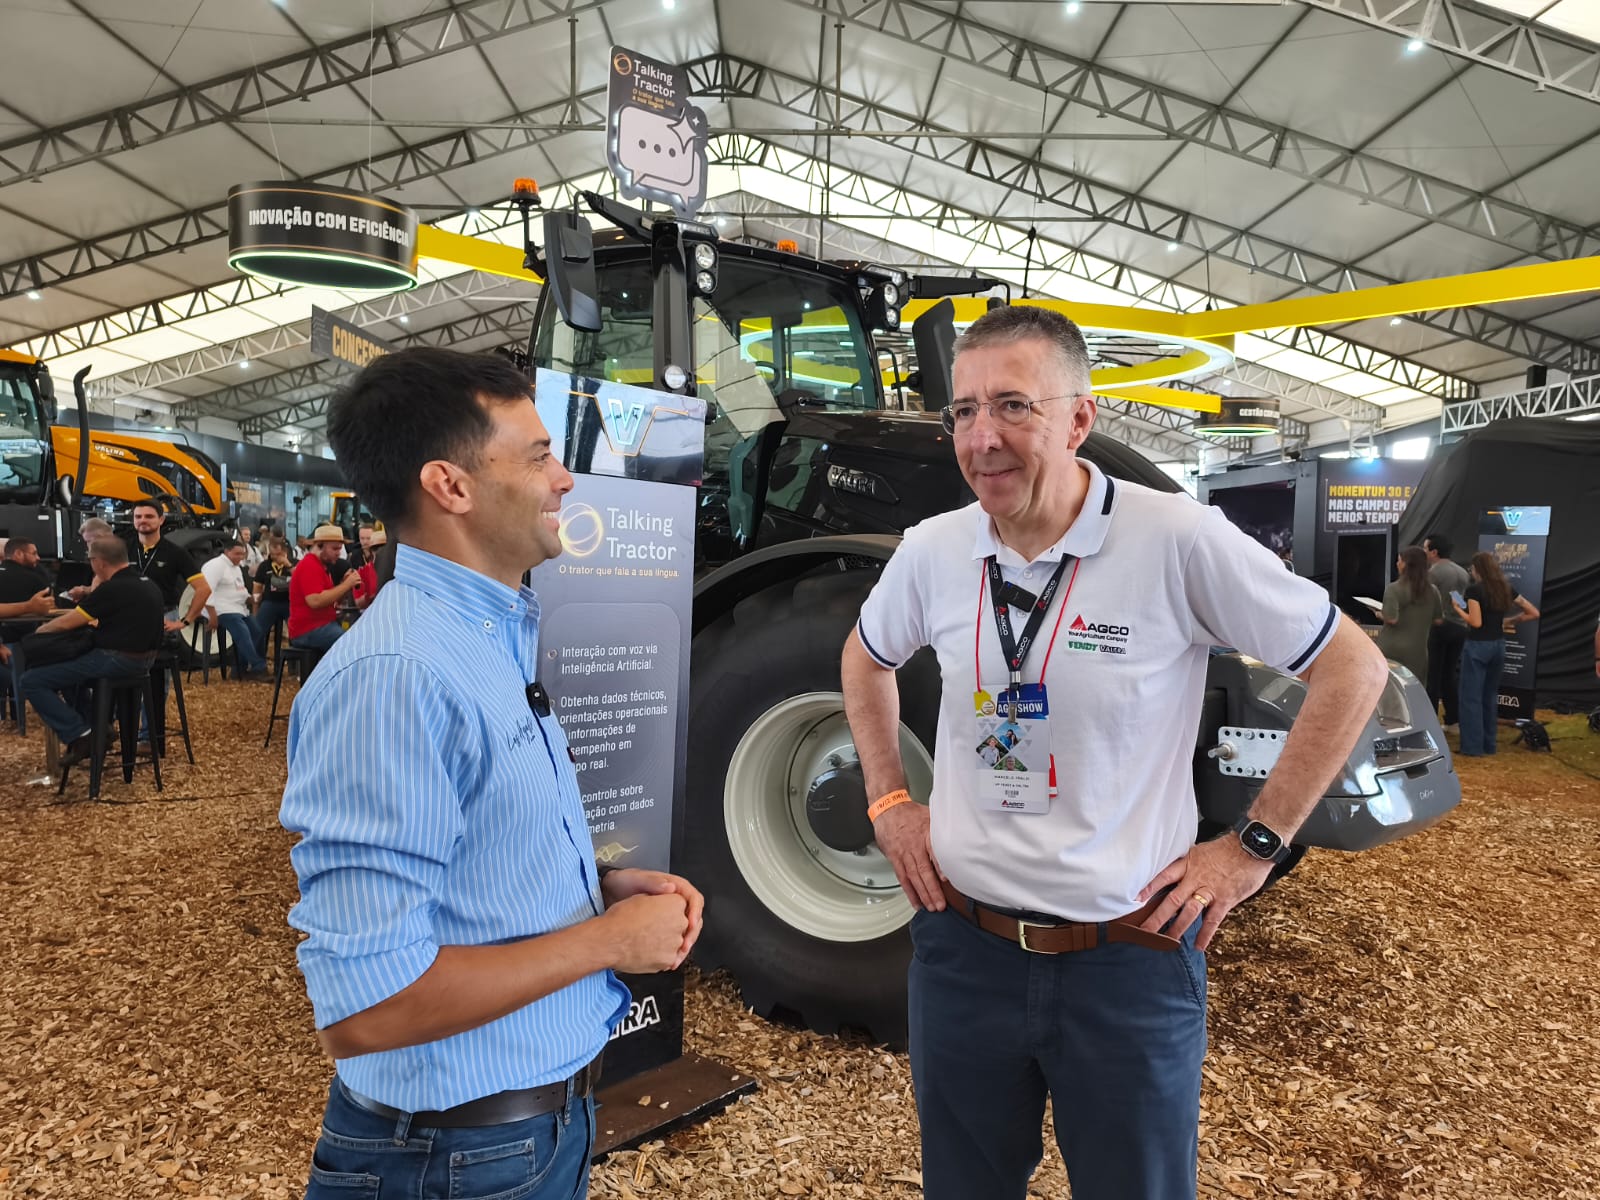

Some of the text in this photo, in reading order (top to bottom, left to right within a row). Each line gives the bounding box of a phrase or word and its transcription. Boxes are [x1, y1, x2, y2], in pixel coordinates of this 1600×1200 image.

[633, 59, 673, 86] Talking
[633, 74, 675, 98] Tractor
[248, 206, 409, 248] INOVAÇÃO COM EFICIÊNCIA
[1329, 485, 1386, 497] MOMENTUM
[1388, 486, 1402, 497] 30
[1404, 486, 1411, 497] E
[1328, 499, 1407, 511] MAIS CAMPO EM
[606, 507, 673, 537] Talking
[1328, 511, 1400, 524] MENOS TEMPO
[606, 537, 677, 560] Tractor
[559, 564, 566, 574] O
[569, 565, 594, 575] trator
[596, 567, 612, 577] que
[614, 566, 629, 576] fala
[631, 568, 637, 576] a
[639, 568, 653, 576] sua
[1087, 622, 1129, 636] AGCO
[562, 643, 658, 659] Interação com voz via
[1016, 636, 1028, 658] AGCO
[1068, 640, 1126, 655] FENDT VALTRA
[561, 659, 654, 675] Inteligência Artificial.
[561, 689, 667, 708] Obtenha dados técnicos,
[560, 704, 668, 725] orientações operacionais
[997, 702, 1043, 713] AGSHOW
[568, 722, 636, 740] informações de
[570, 740, 632, 756] sempenho em
[589, 757, 609, 770] real.
[581, 784, 643, 803] controle sobre
[608, 803, 627, 815] com
[629, 798, 654, 811] dados
